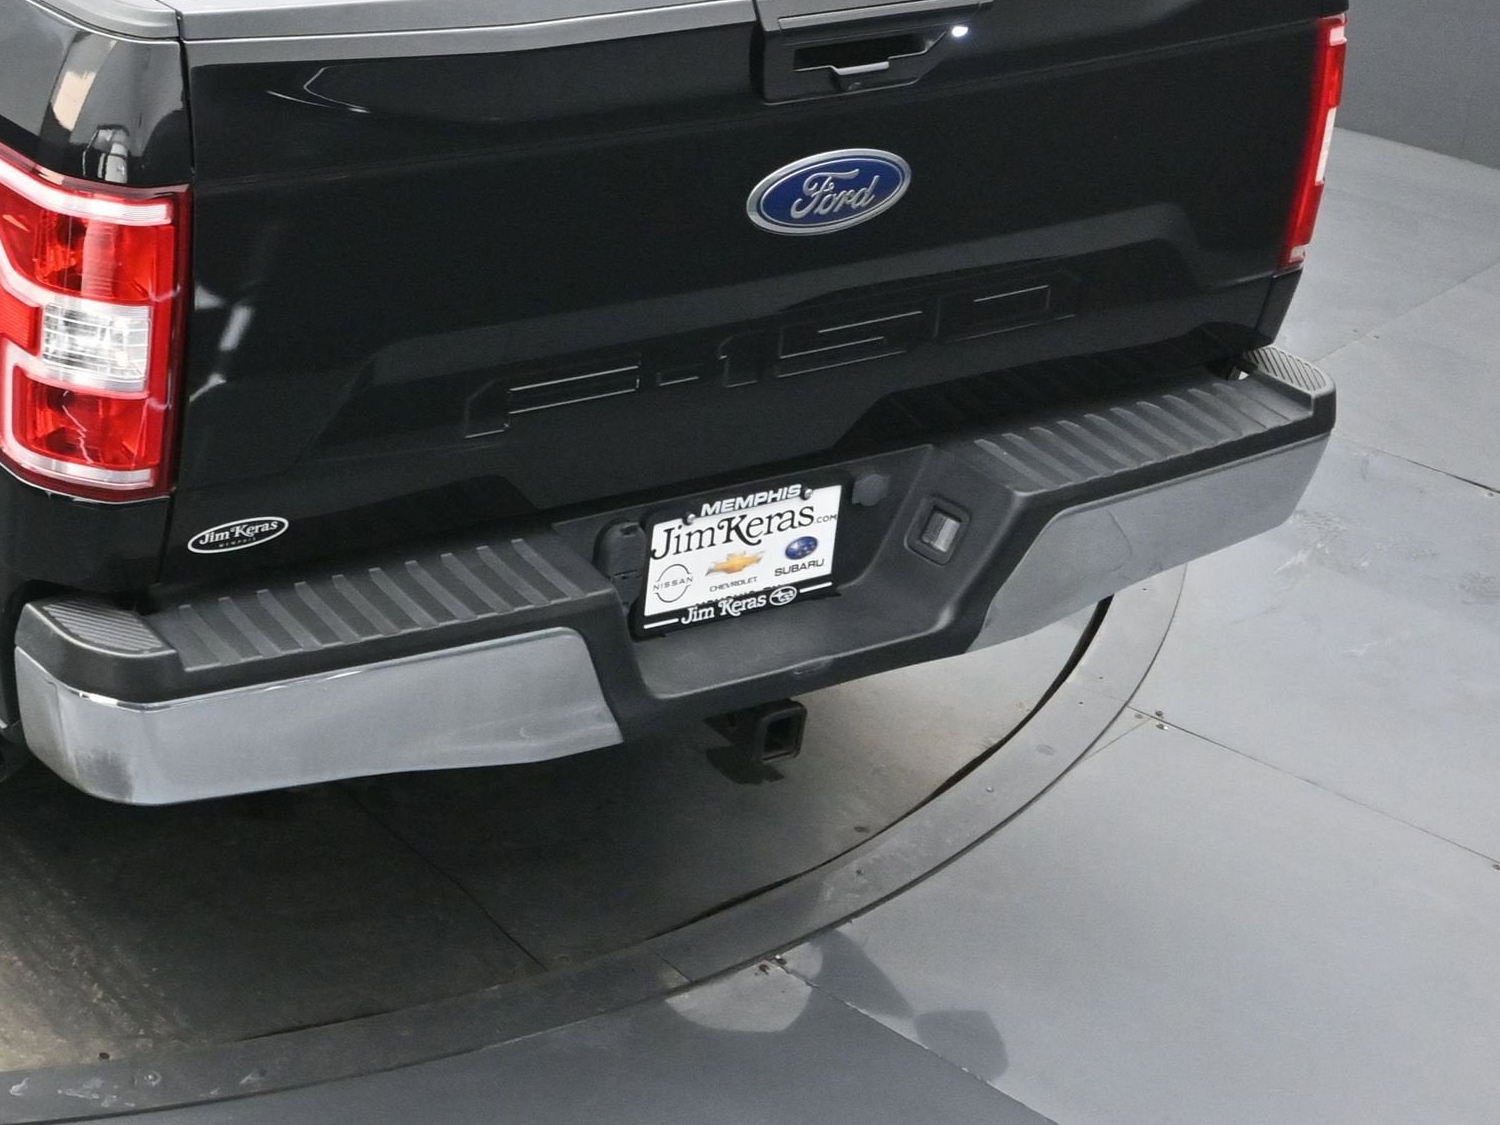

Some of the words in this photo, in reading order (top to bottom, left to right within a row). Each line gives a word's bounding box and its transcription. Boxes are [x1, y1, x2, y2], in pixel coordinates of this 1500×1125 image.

[789, 168, 881, 219] Ford
[700, 483, 803, 517] MEMPHIS
[774, 558, 825, 577] SUBARU
[652, 575, 694, 591] NISSAN
[709, 576, 759, 593] CHEVROLET
[680, 606, 716, 625] Jim
[717, 594, 767, 617] Keras
